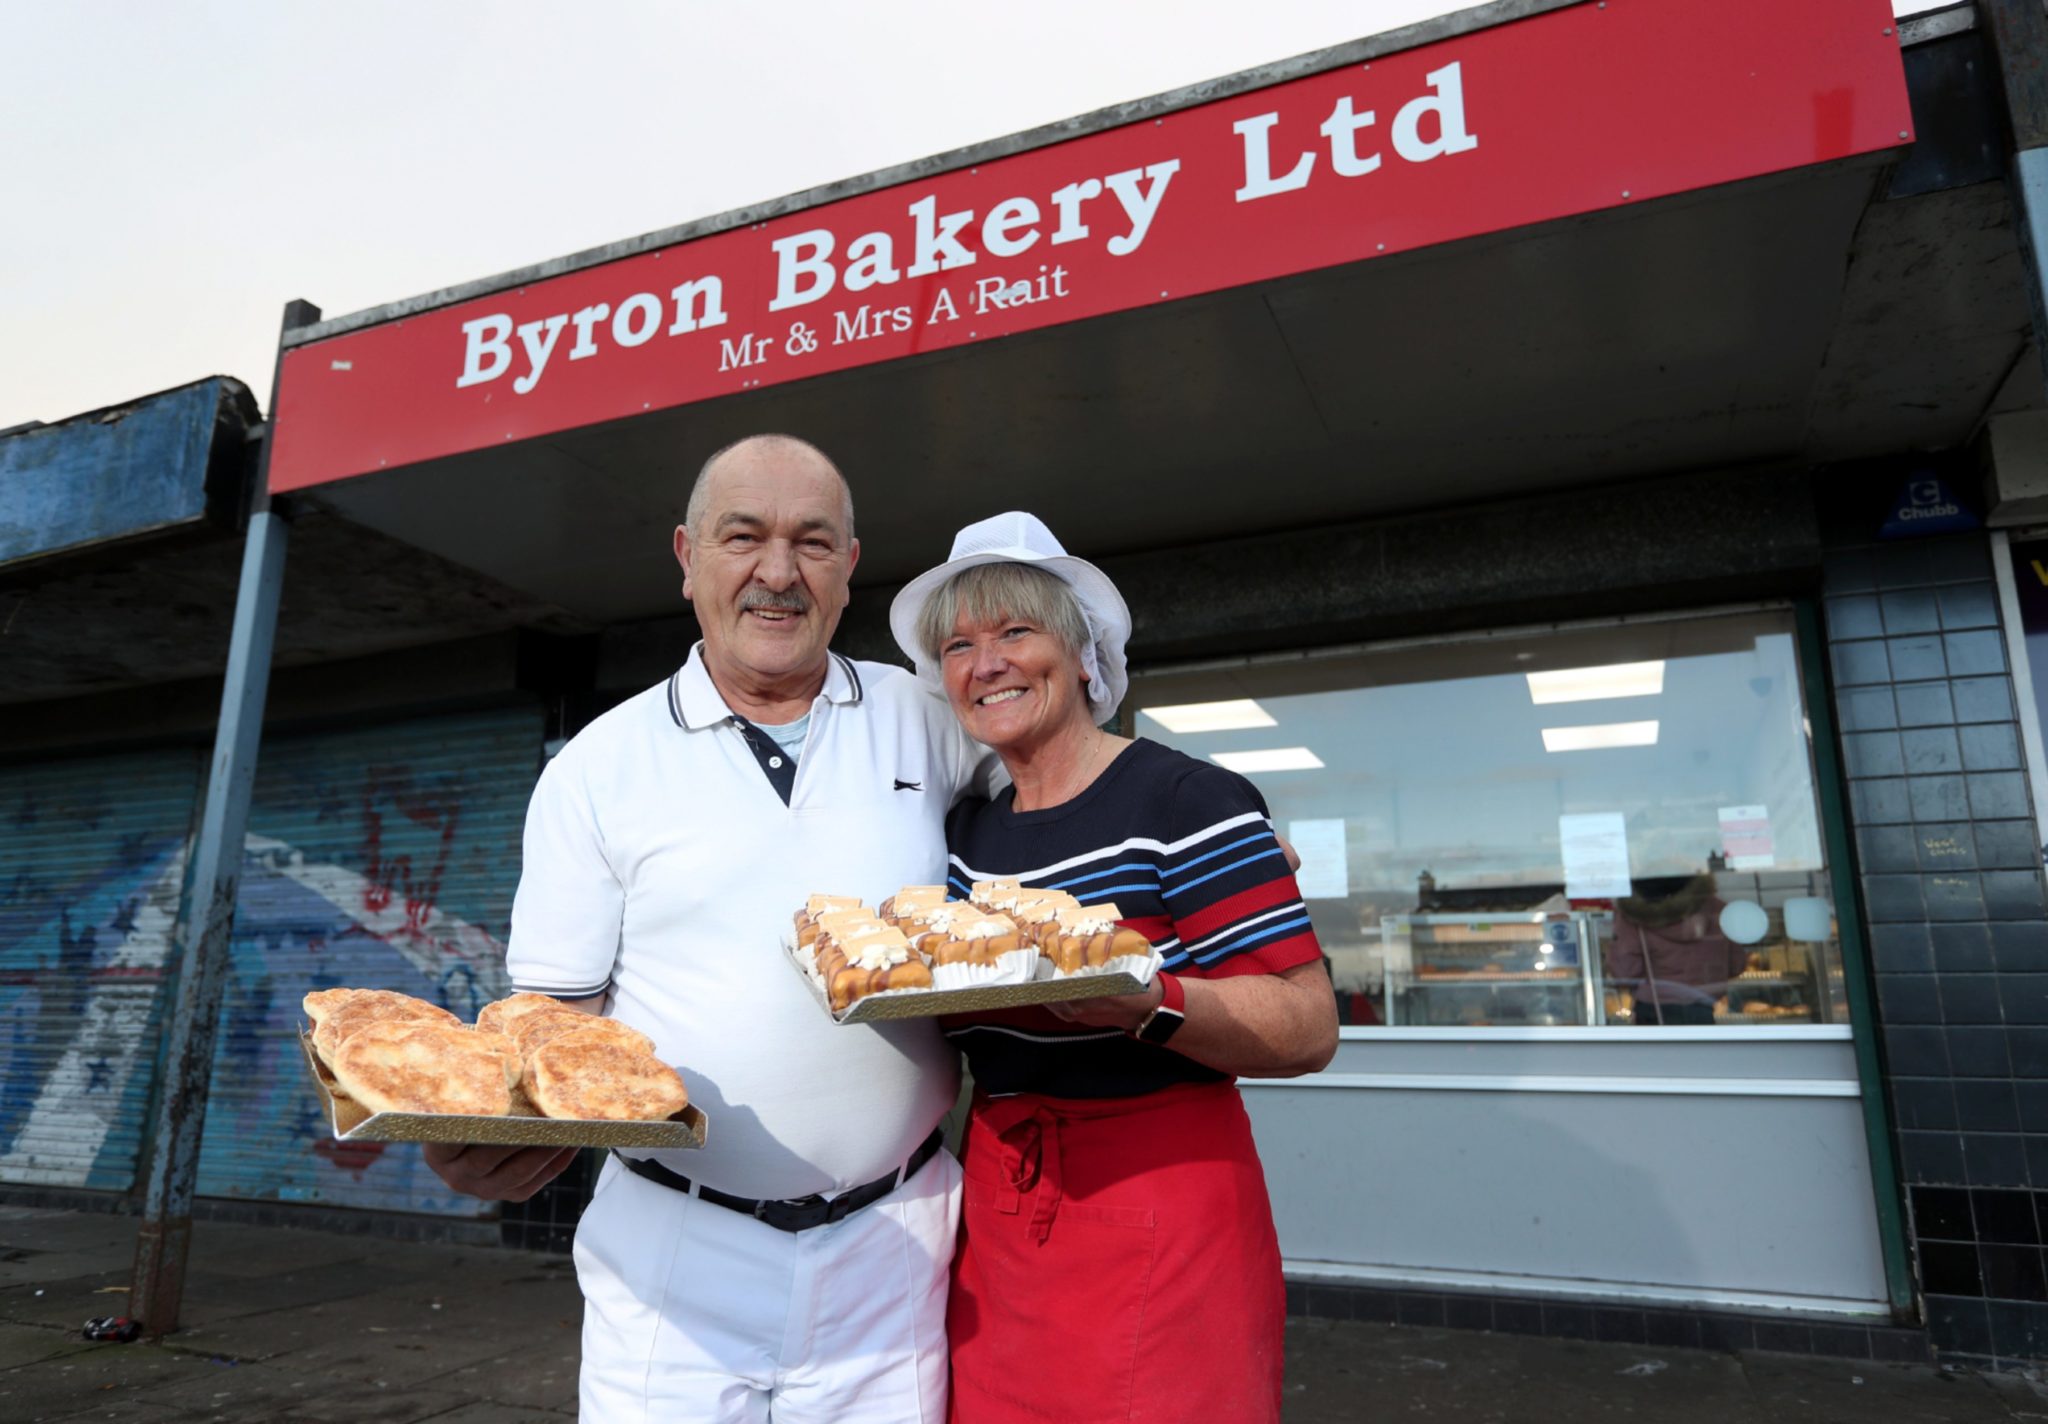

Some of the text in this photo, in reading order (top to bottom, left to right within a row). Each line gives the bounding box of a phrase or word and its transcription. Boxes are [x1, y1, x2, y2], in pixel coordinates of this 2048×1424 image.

[455, 60, 1479, 395] Byron Bakery Ltd
[718, 264, 1069, 372] Mr & Mrs A Rait
[1898, 503, 1959, 520] Chubb
